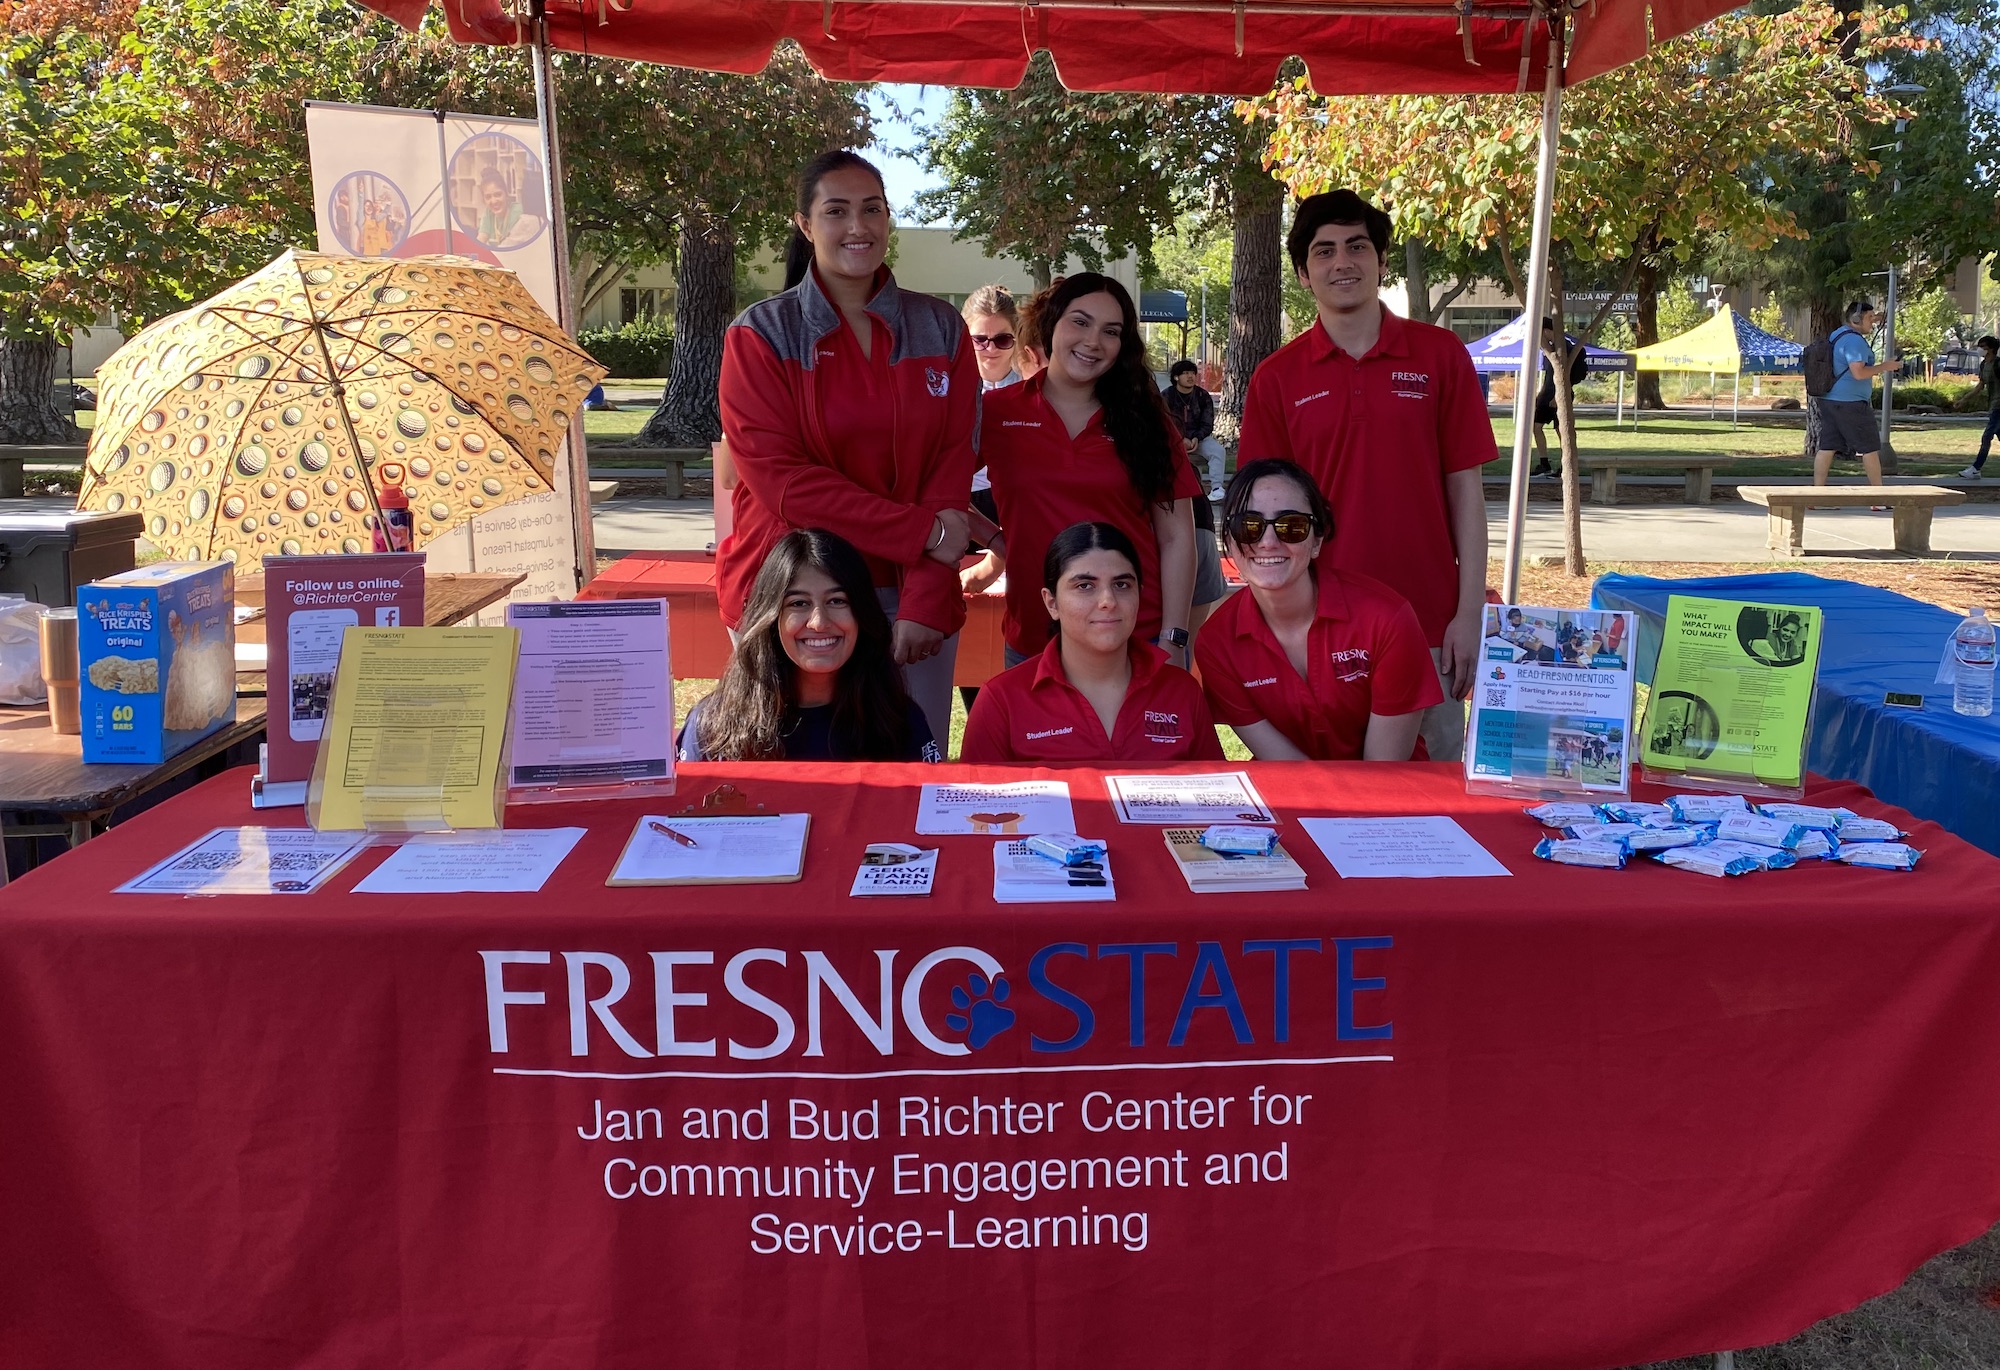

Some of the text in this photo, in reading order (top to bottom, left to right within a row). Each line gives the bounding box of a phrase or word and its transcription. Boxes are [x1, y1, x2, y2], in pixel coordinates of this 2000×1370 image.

[1593, 357, 1628, 366] HOMECOMING
[1295, 389, 1330, 408] Student Leader
[286, 578, 404, 592] Follow us online.
[188, 594, 212, 614] TREATS
[293, 591, 397, 605] @RichterCenter
[99, 609, 152, 620] RICE KRISPIES
[1683, 612, 1707, 620] WHAT
[100, 618, 152, 631] TREATS
[1681, 620, 1733, 632] IMPACT WILL
[1681, 628, 1728, 640] YOU MAKE?
[1593, 656, 1620, 664] AFTERSCHOOL
[1259, 677, 1277, 686] Leader
[1517, 669, 1615, 685] READ FRESNO MENTORS
[1483, 681, 1497, 689] Apply
[1520, 686, 1546, 696] Starting
[1547, 688, 1560, 697] Pay
[1568, 689, 1581, 697] $16
[1582, 691, 1593, 699] per
[1595, 691, 1610, 699] hour
[112, 705, 134, 722] 60
[112, 723, 134, 731] BARS
[1484, 720, 1504, 728] MENTOR
[1026, 726, 1073, 740] Student Leader
[1483, 730, 1501, 738] SCHOOL
[1483, 740, 1496, 748] WITH
[1756, 744, 1778, 753] STATE
[1481, 750, 1502, 758] READING
[995, 785, 1049, 793] CENTER
[477, 935, 1394, 1061] FRESNO STATE
[577, 1085, 1312, 1142] Jan and Bud Richter Center for
[602, 1141, 1288, 1208] Community Engagement and
[749, 1206, 1150, 1257] Service-Learning
